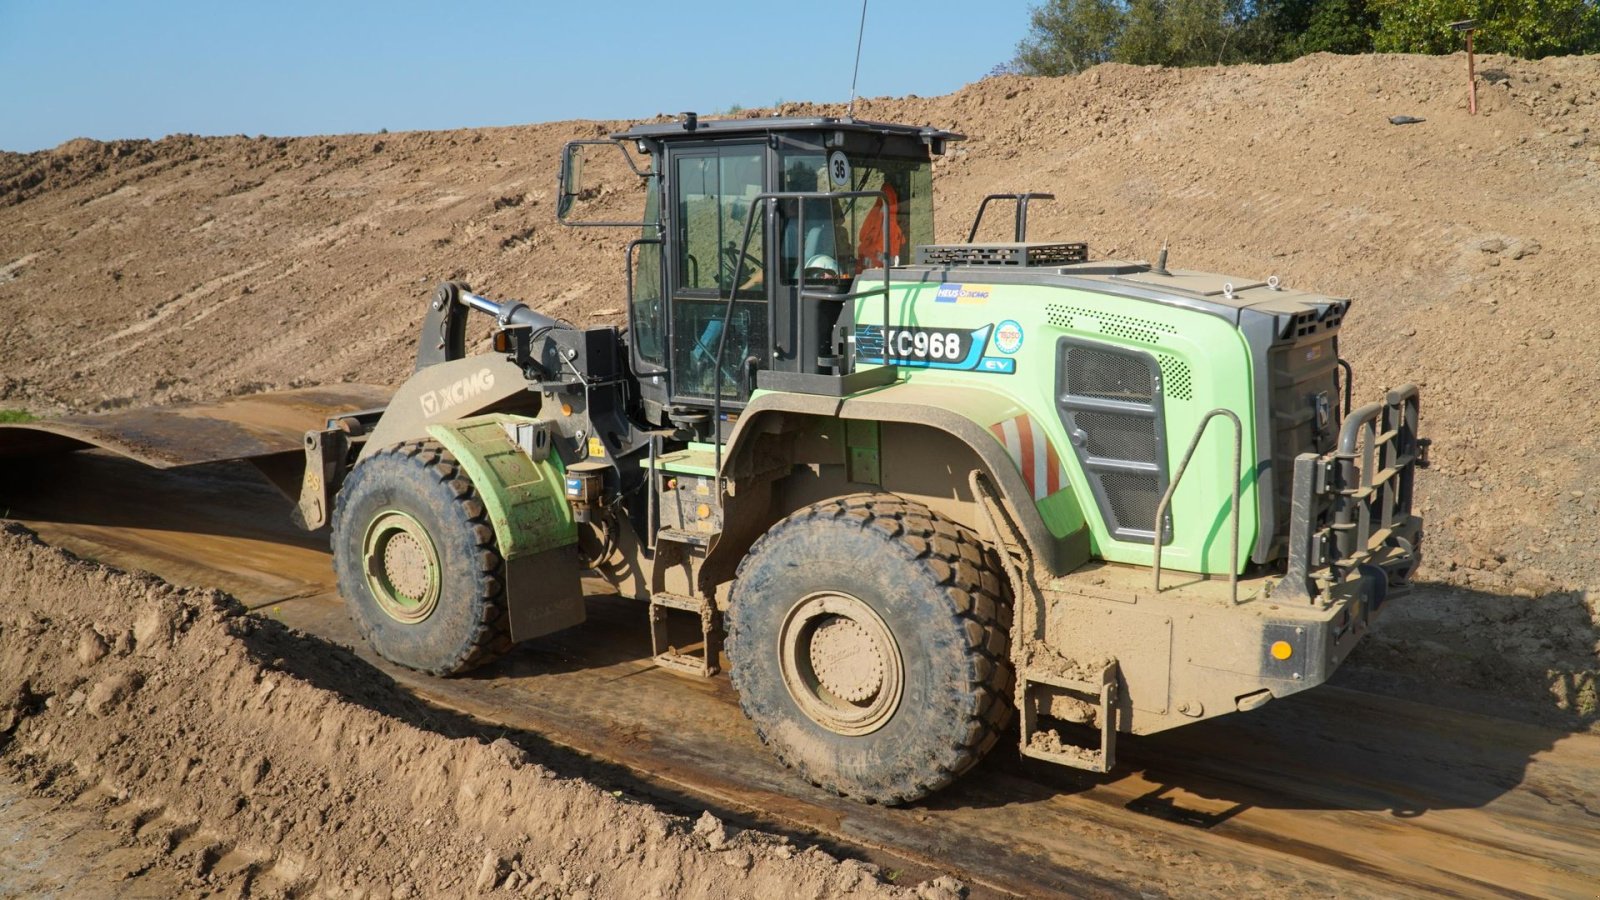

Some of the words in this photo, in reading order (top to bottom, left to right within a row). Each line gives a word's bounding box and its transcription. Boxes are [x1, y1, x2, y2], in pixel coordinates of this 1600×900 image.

[834, 159, 846, 179] 36
[938, 289, 961, 298] HEUS
[880, 329, 960, 360] XC968
[985, 360, 1009, 370] EV
[438, 368, 495, 411] XCMG
